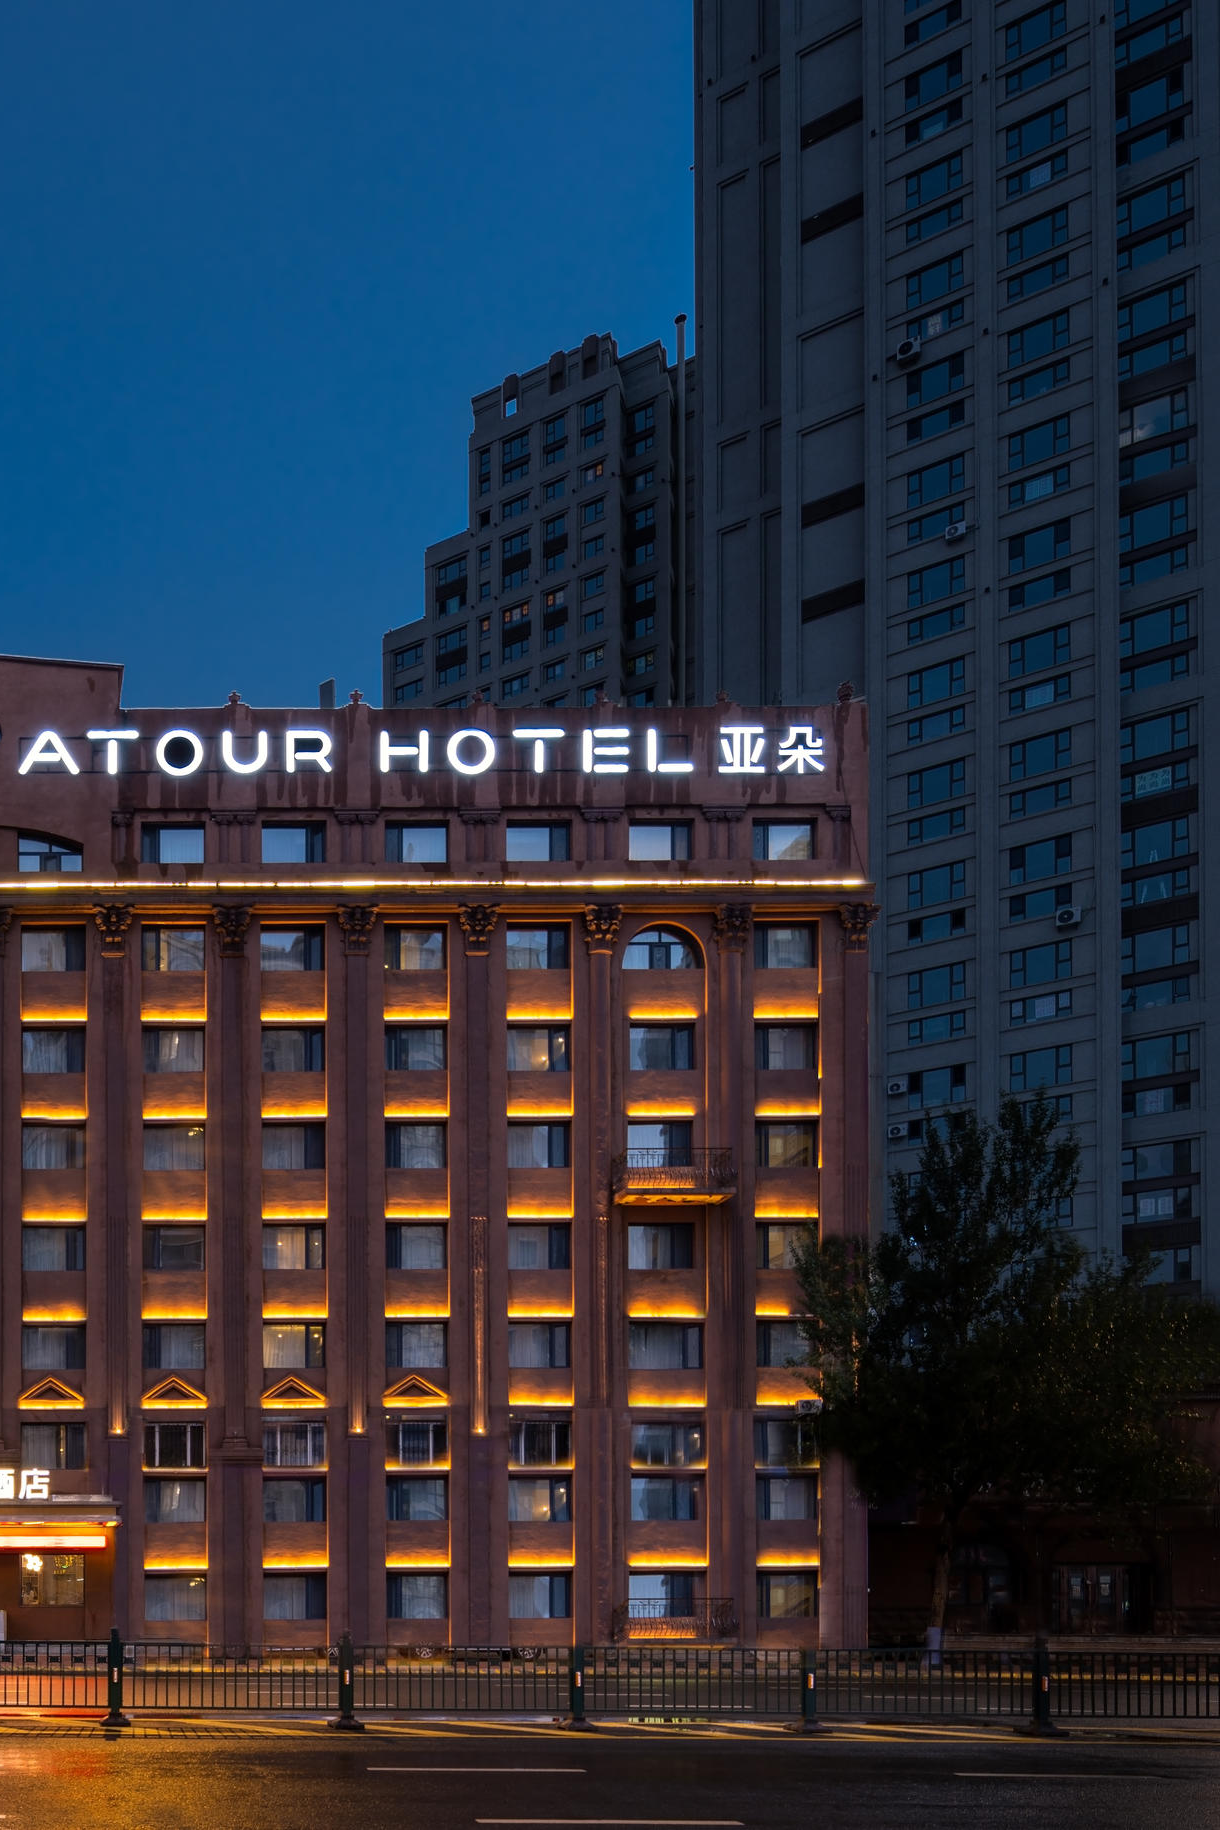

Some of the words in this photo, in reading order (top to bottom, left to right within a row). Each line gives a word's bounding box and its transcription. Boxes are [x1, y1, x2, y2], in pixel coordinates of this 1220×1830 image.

[18, 729, 332, 776] ATOUR
[380, 729, 694, 775] HOTEL
[718, 726, 825, 773] 亚朵
